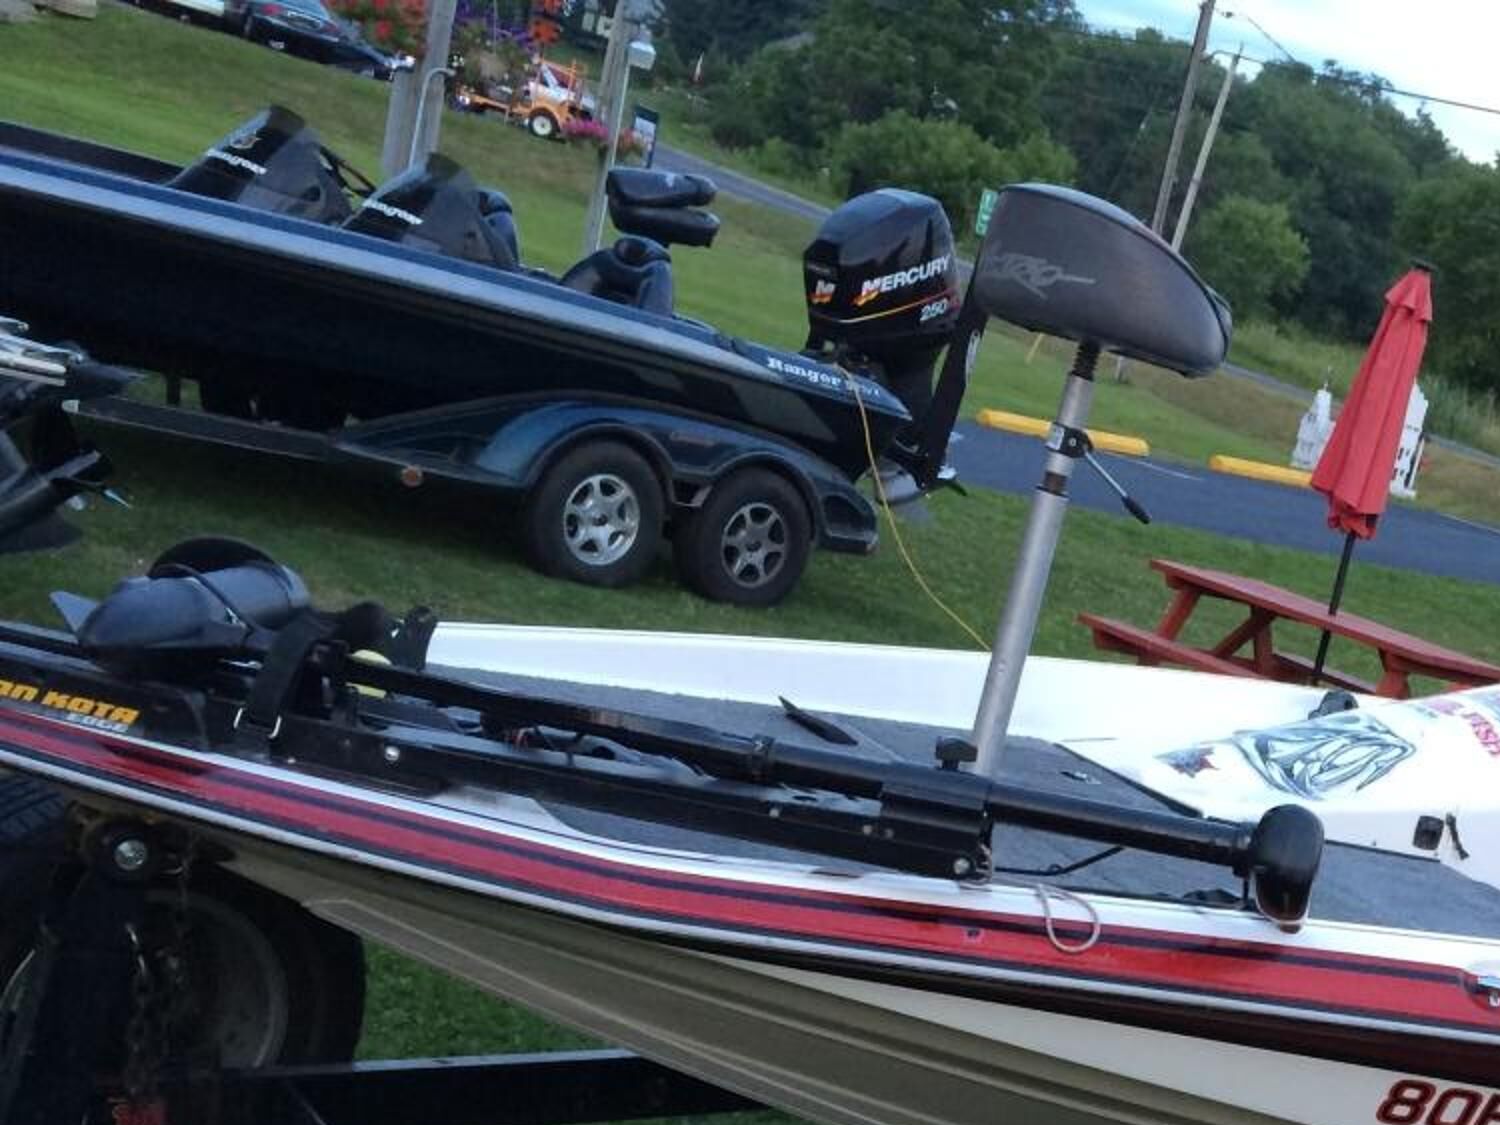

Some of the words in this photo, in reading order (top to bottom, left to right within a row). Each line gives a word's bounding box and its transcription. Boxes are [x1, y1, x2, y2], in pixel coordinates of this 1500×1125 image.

[861, 254, 950, 297] MERCURY
[767, 357, 842, 386] Ranger
[41, 691, 140, 726] KOTA
